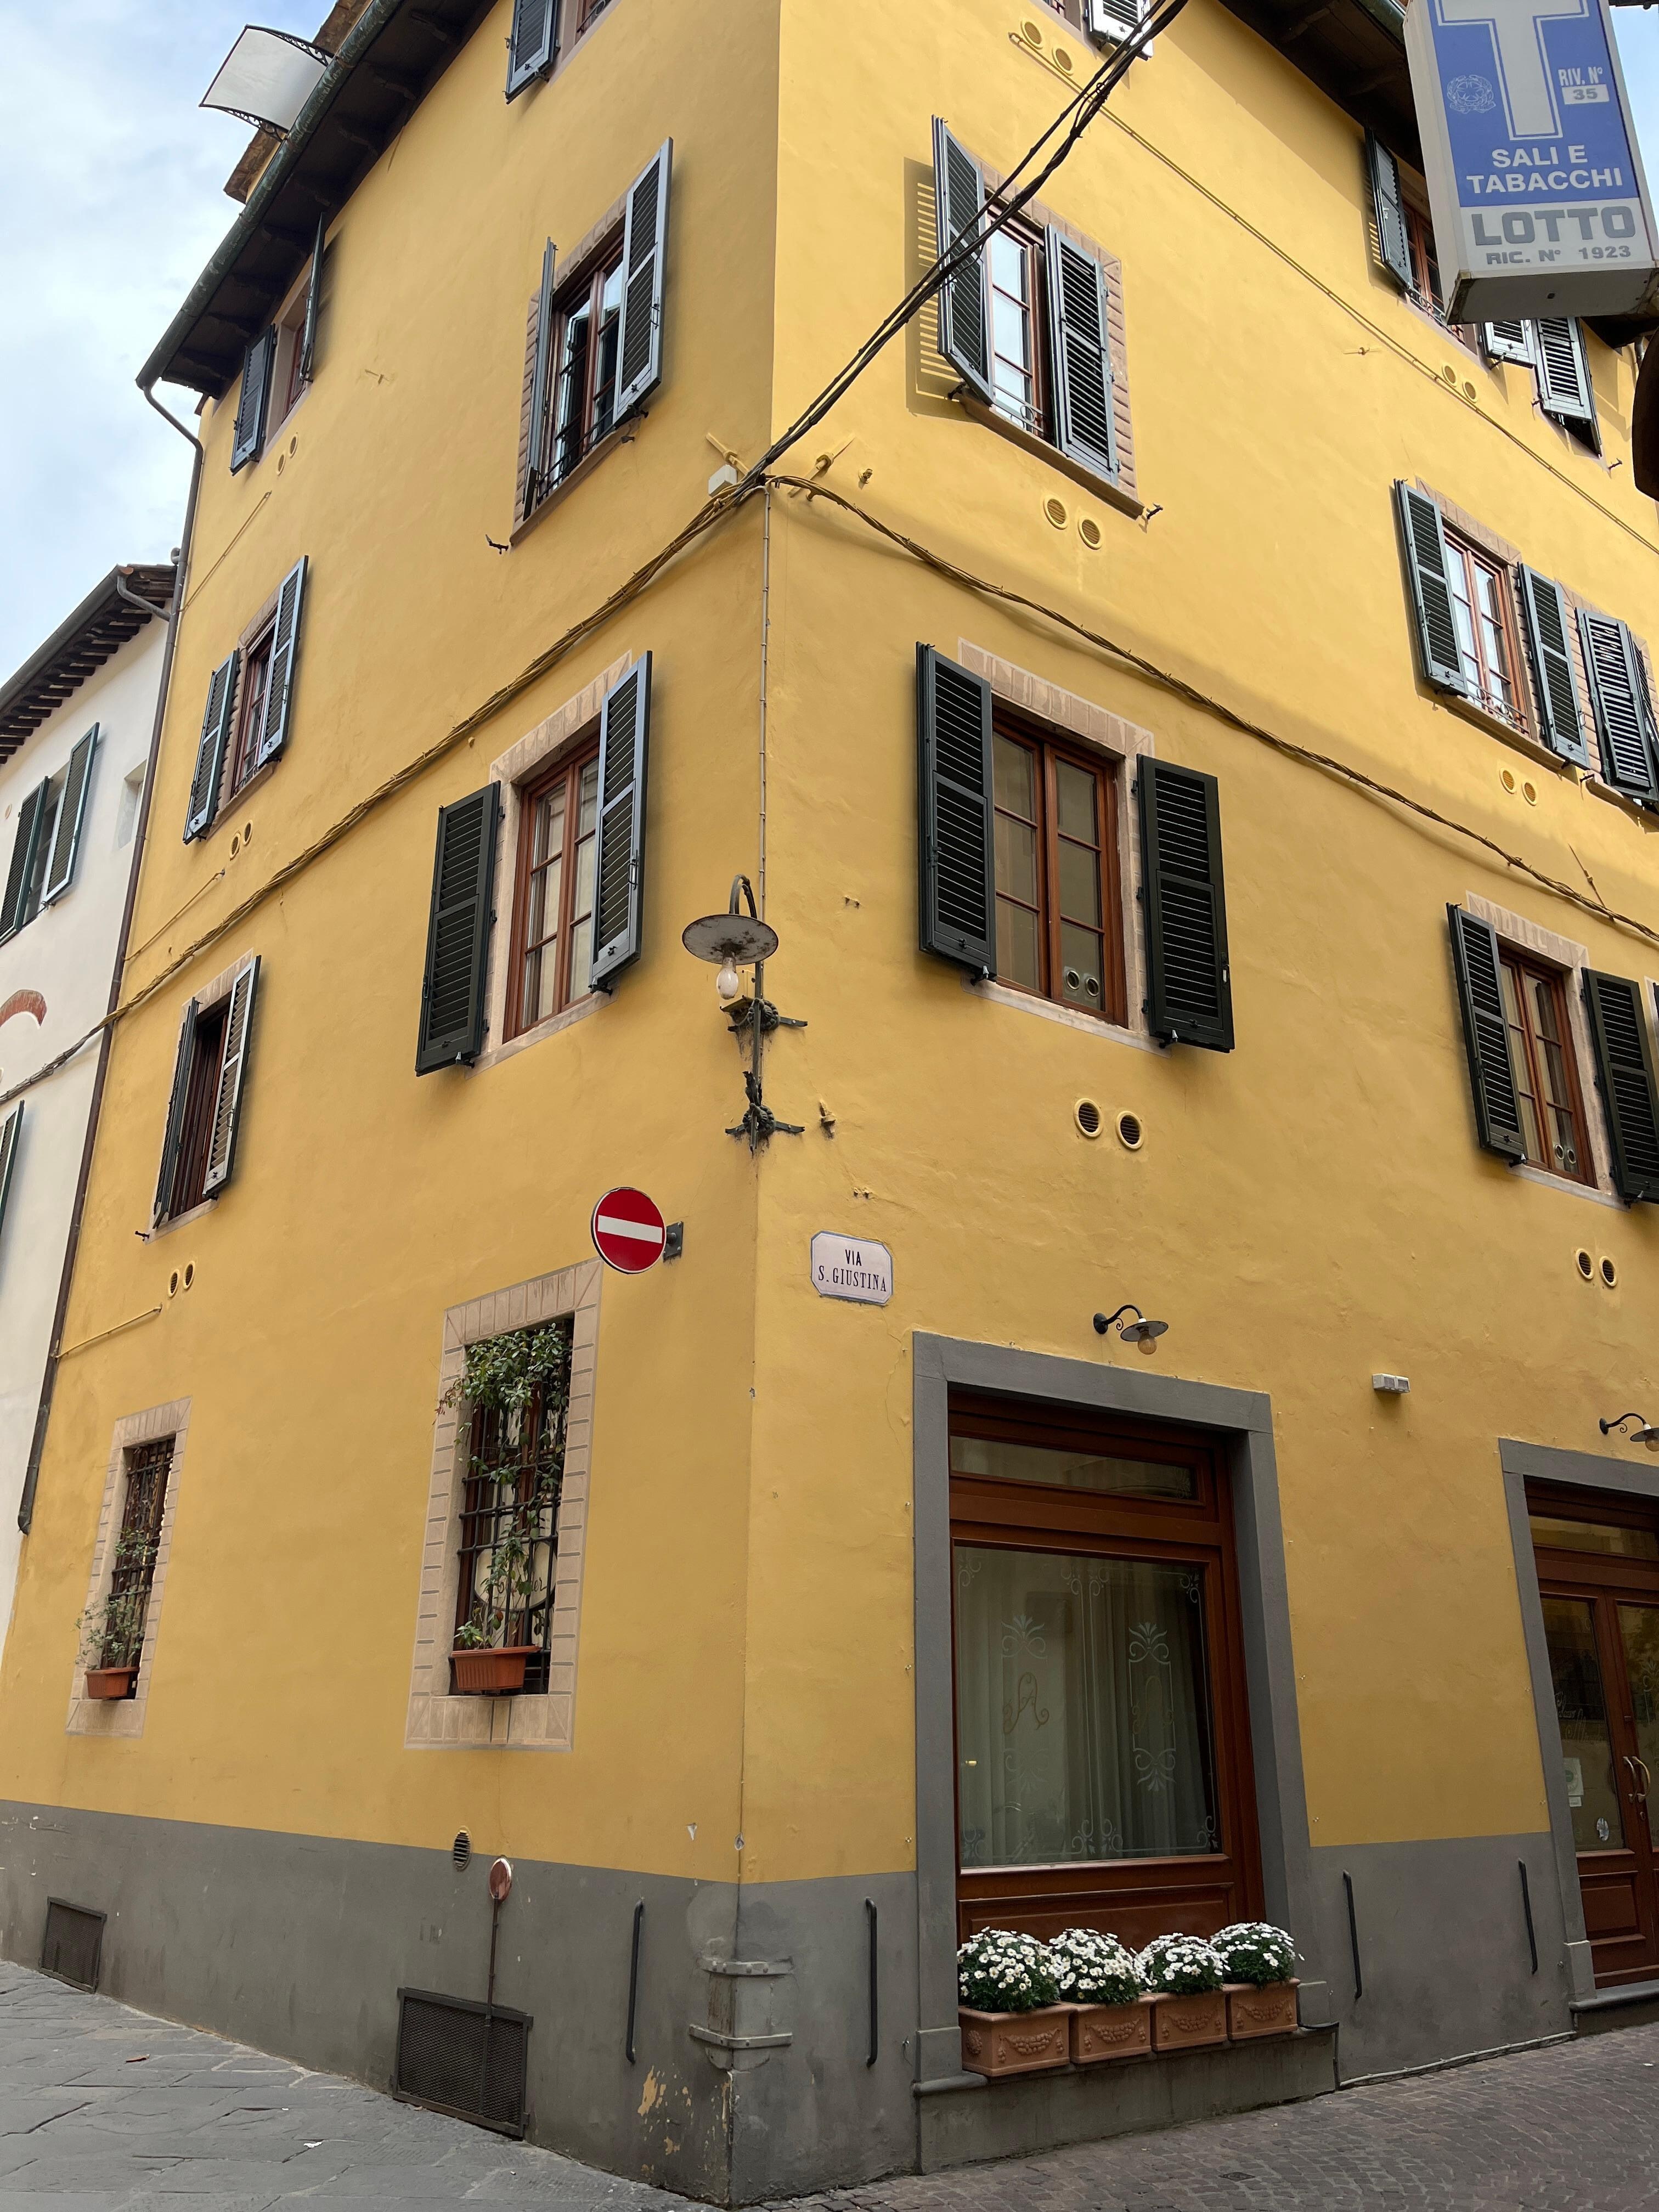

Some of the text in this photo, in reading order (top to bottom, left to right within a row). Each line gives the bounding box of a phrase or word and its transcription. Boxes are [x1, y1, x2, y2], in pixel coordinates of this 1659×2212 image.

[1558, 67, 1585, 86] RIV.
[1573, 88, 1598, 100] 35
[1491, 144, 1588, 168] SALI E
[1466, 167, 1623, 194] TABACCHI
[1471, 206, 1636, 246] LOTTO
[1486, 251, 1531, 265] RIC.
[1578, 245, 1632, 259] 1923
[845, 1249, 862, 1266] VIA
[818, 1265, 887, 1292] S. GIUSTINA
